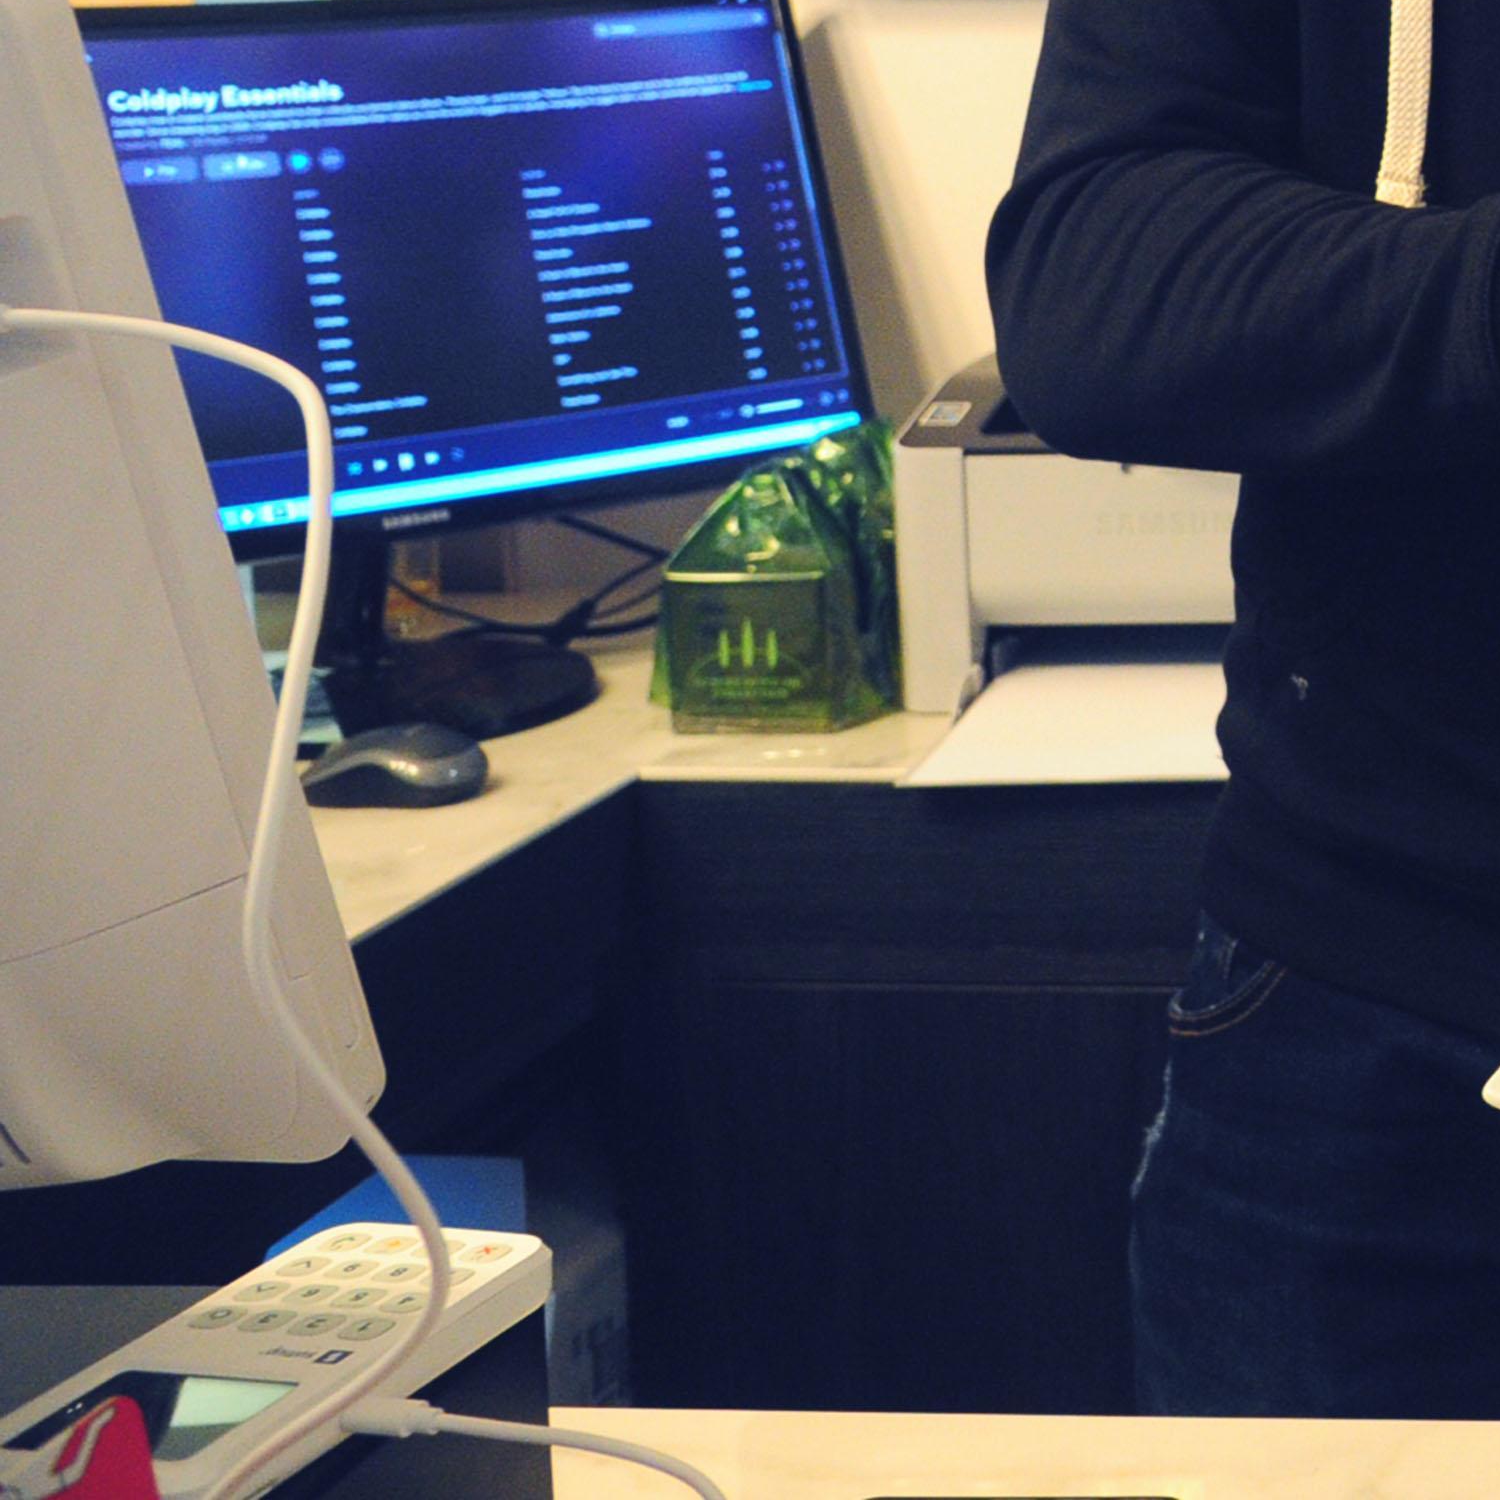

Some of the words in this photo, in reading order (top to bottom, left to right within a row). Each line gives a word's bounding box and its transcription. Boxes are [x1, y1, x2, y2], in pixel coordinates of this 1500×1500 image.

[107, 85, 220, 115] Coldplay
[220, 78, 345, 109] Essentials
[1095, 510, 1234, 536] SAMSUN
